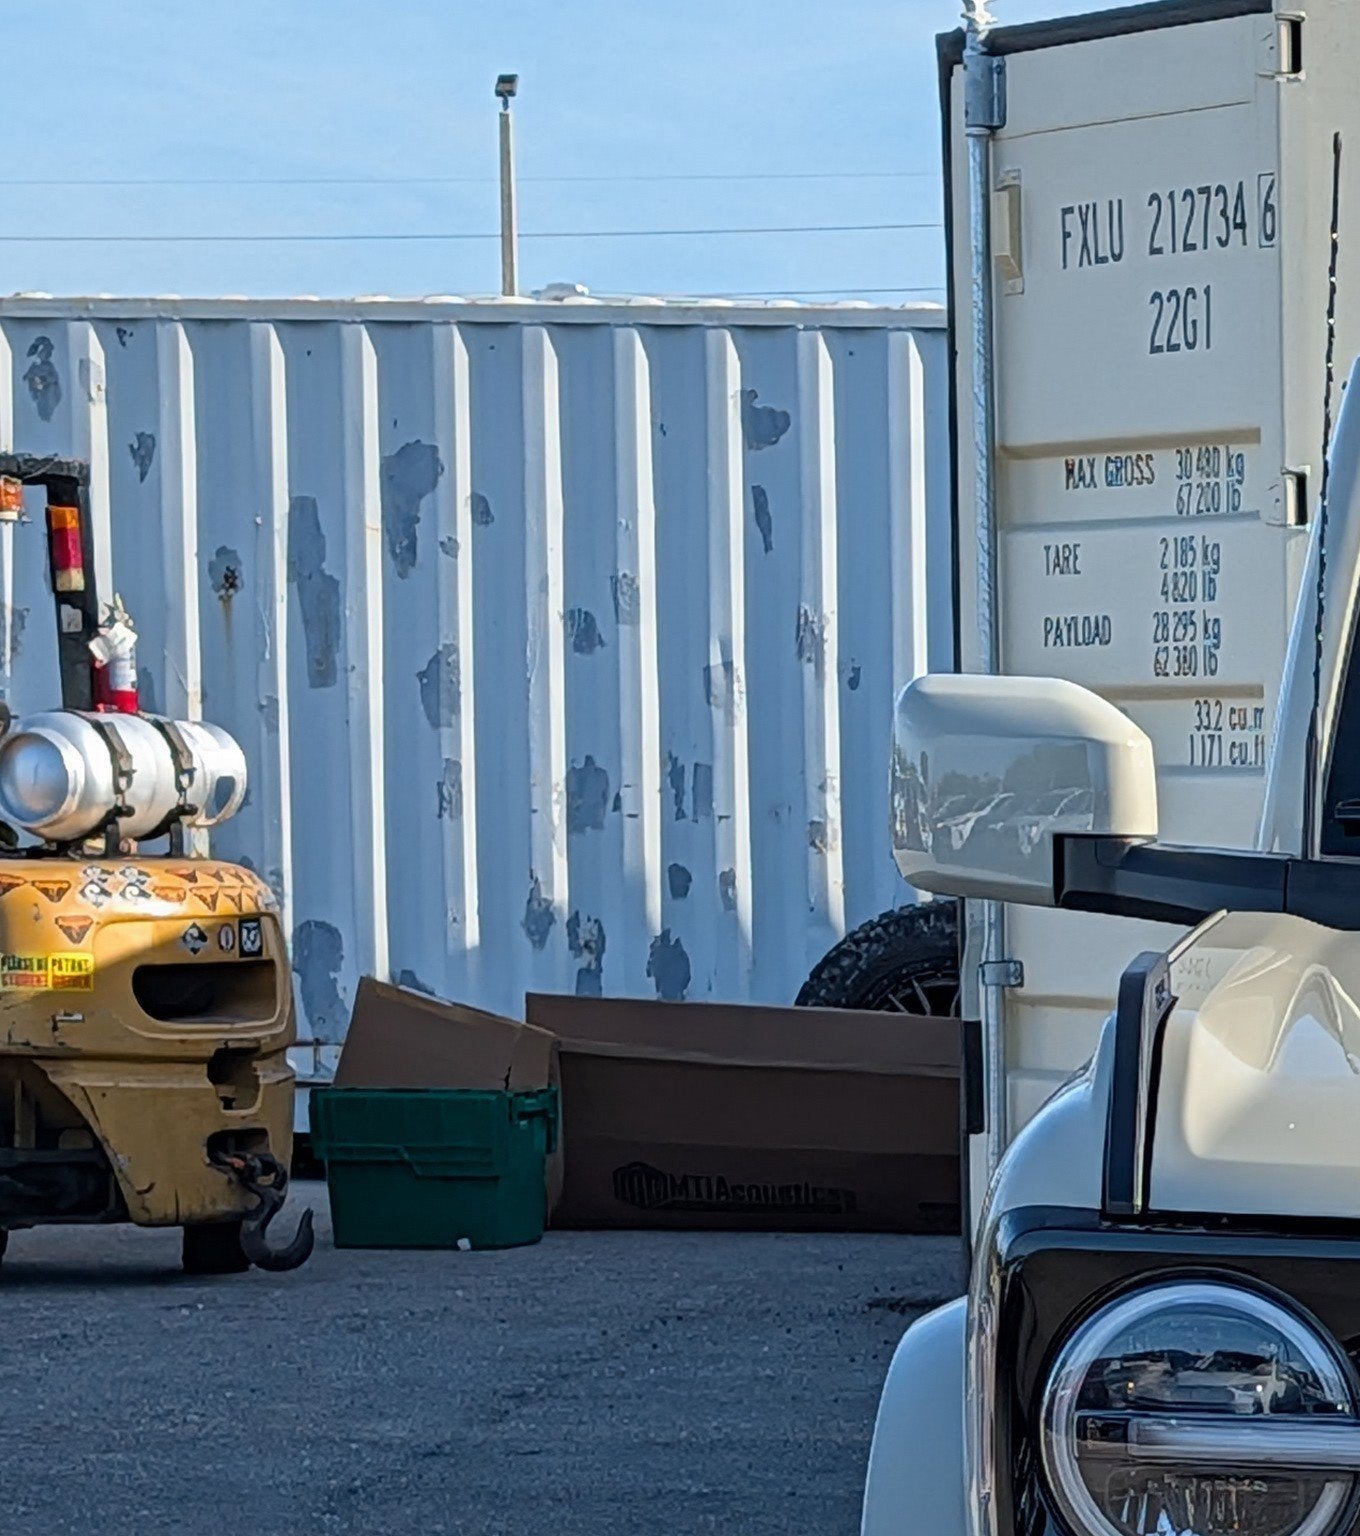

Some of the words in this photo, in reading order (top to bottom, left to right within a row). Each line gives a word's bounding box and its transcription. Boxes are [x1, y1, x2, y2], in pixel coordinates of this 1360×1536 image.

[1061, 199, 1124, 269] FXLU
[1148, 181, 1248, 255] 212734
[1262, 177, 1276, 242] 6
[1149, 285, 1212, 355] 22G1
[1064, 457, 1098, 490] MAX
[1104, 453, 1155, 487] GROSS
[1226, 446, 1245, 485] kg
[1226, 480, 1242, 513] lb
[1044, 543, 1081, 576] TARE
[1202, 535, 1221, 575] kg
[1202, 570, 1217, 602] lb
[1043, 615, 1112, 648] PAYLOAD
[1203, 609, 1221, 650] kg
[1203, 645, 1218, 677] lb
